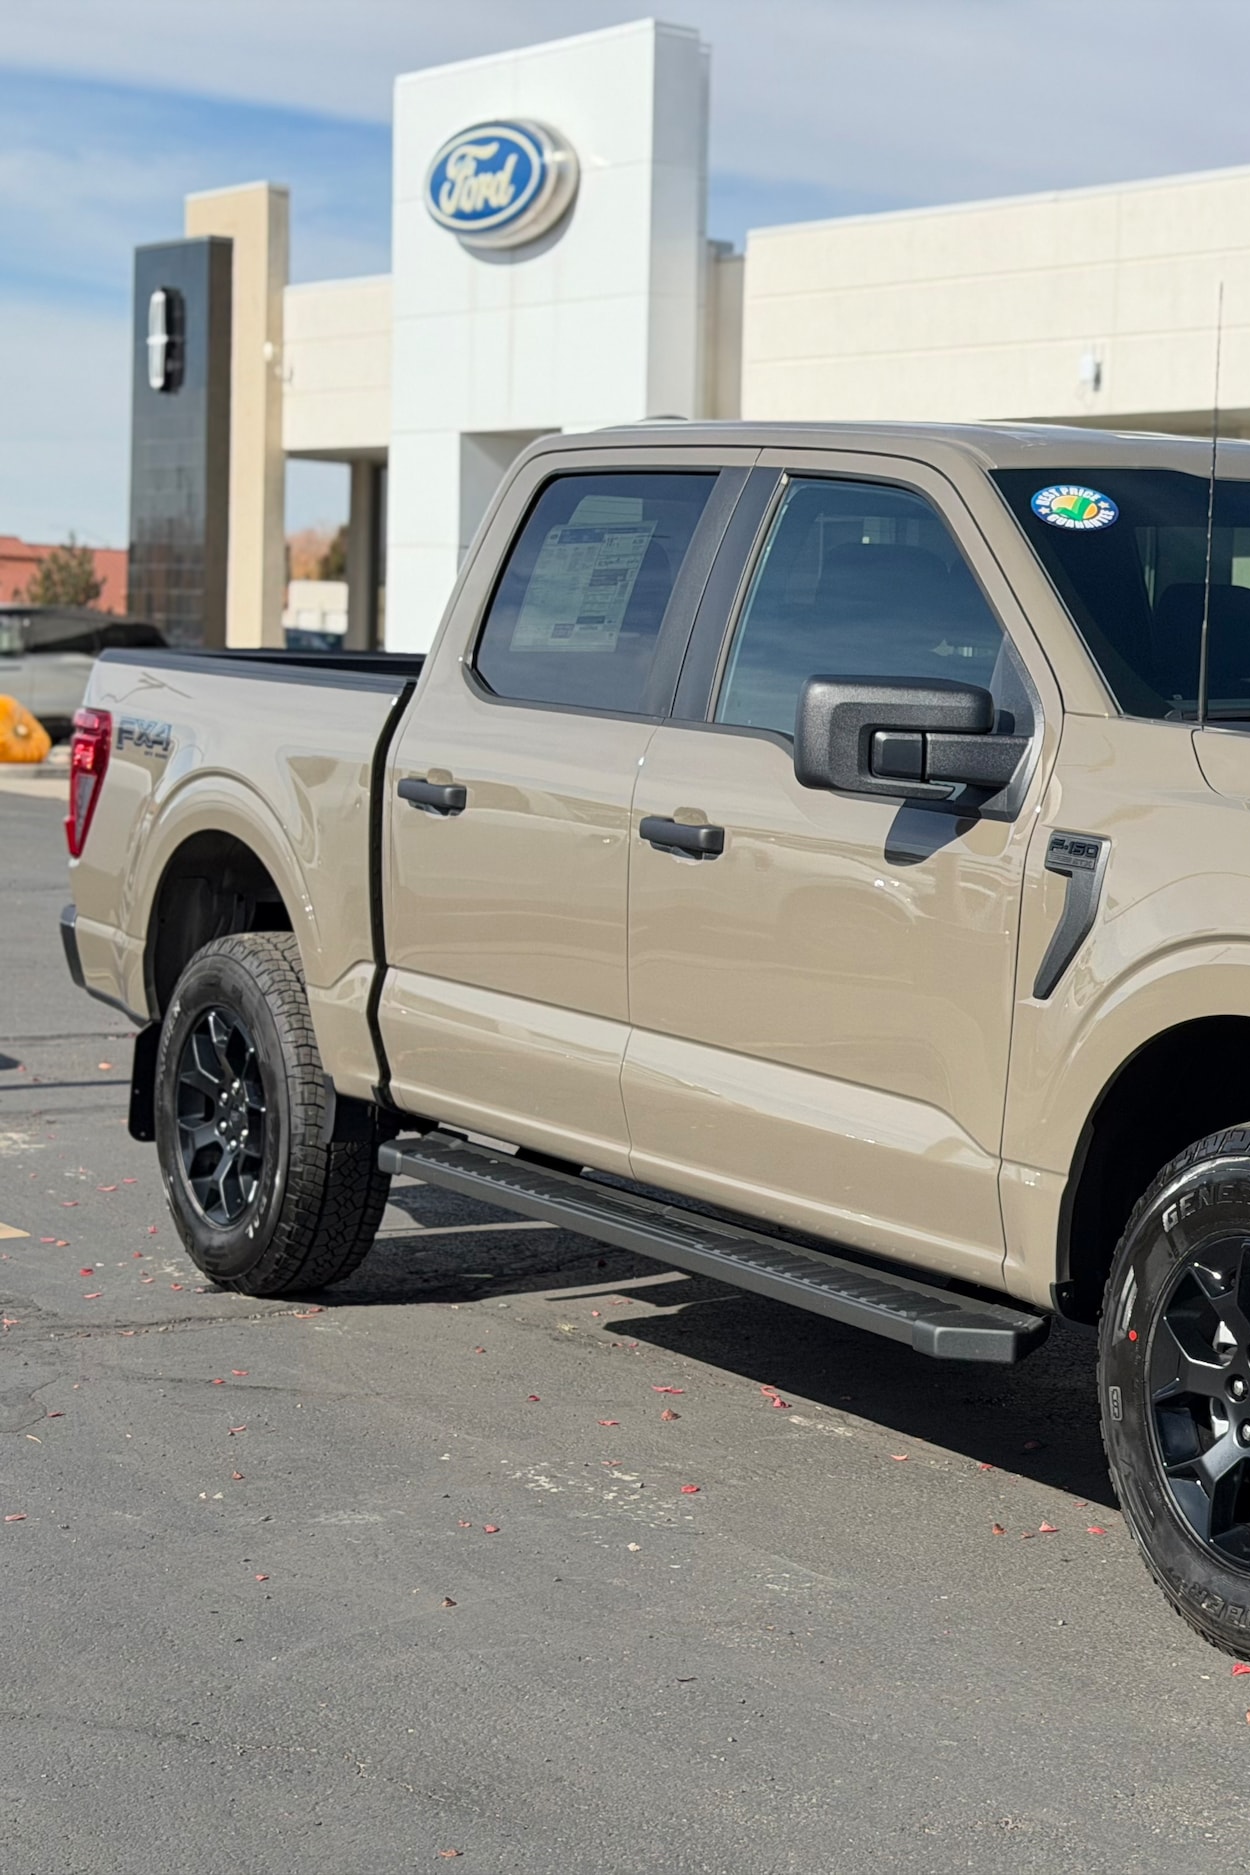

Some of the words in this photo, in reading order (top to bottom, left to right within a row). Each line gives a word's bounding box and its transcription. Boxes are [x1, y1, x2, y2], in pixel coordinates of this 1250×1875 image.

[439, 141, 519, 216] Ford
[1035, 487, 1060, 506] BEST
[1060, 487, 1101, 502] PRICE
[116, 715, 172, 751] FX4
[1048, 838, 1099, 859] F-150
